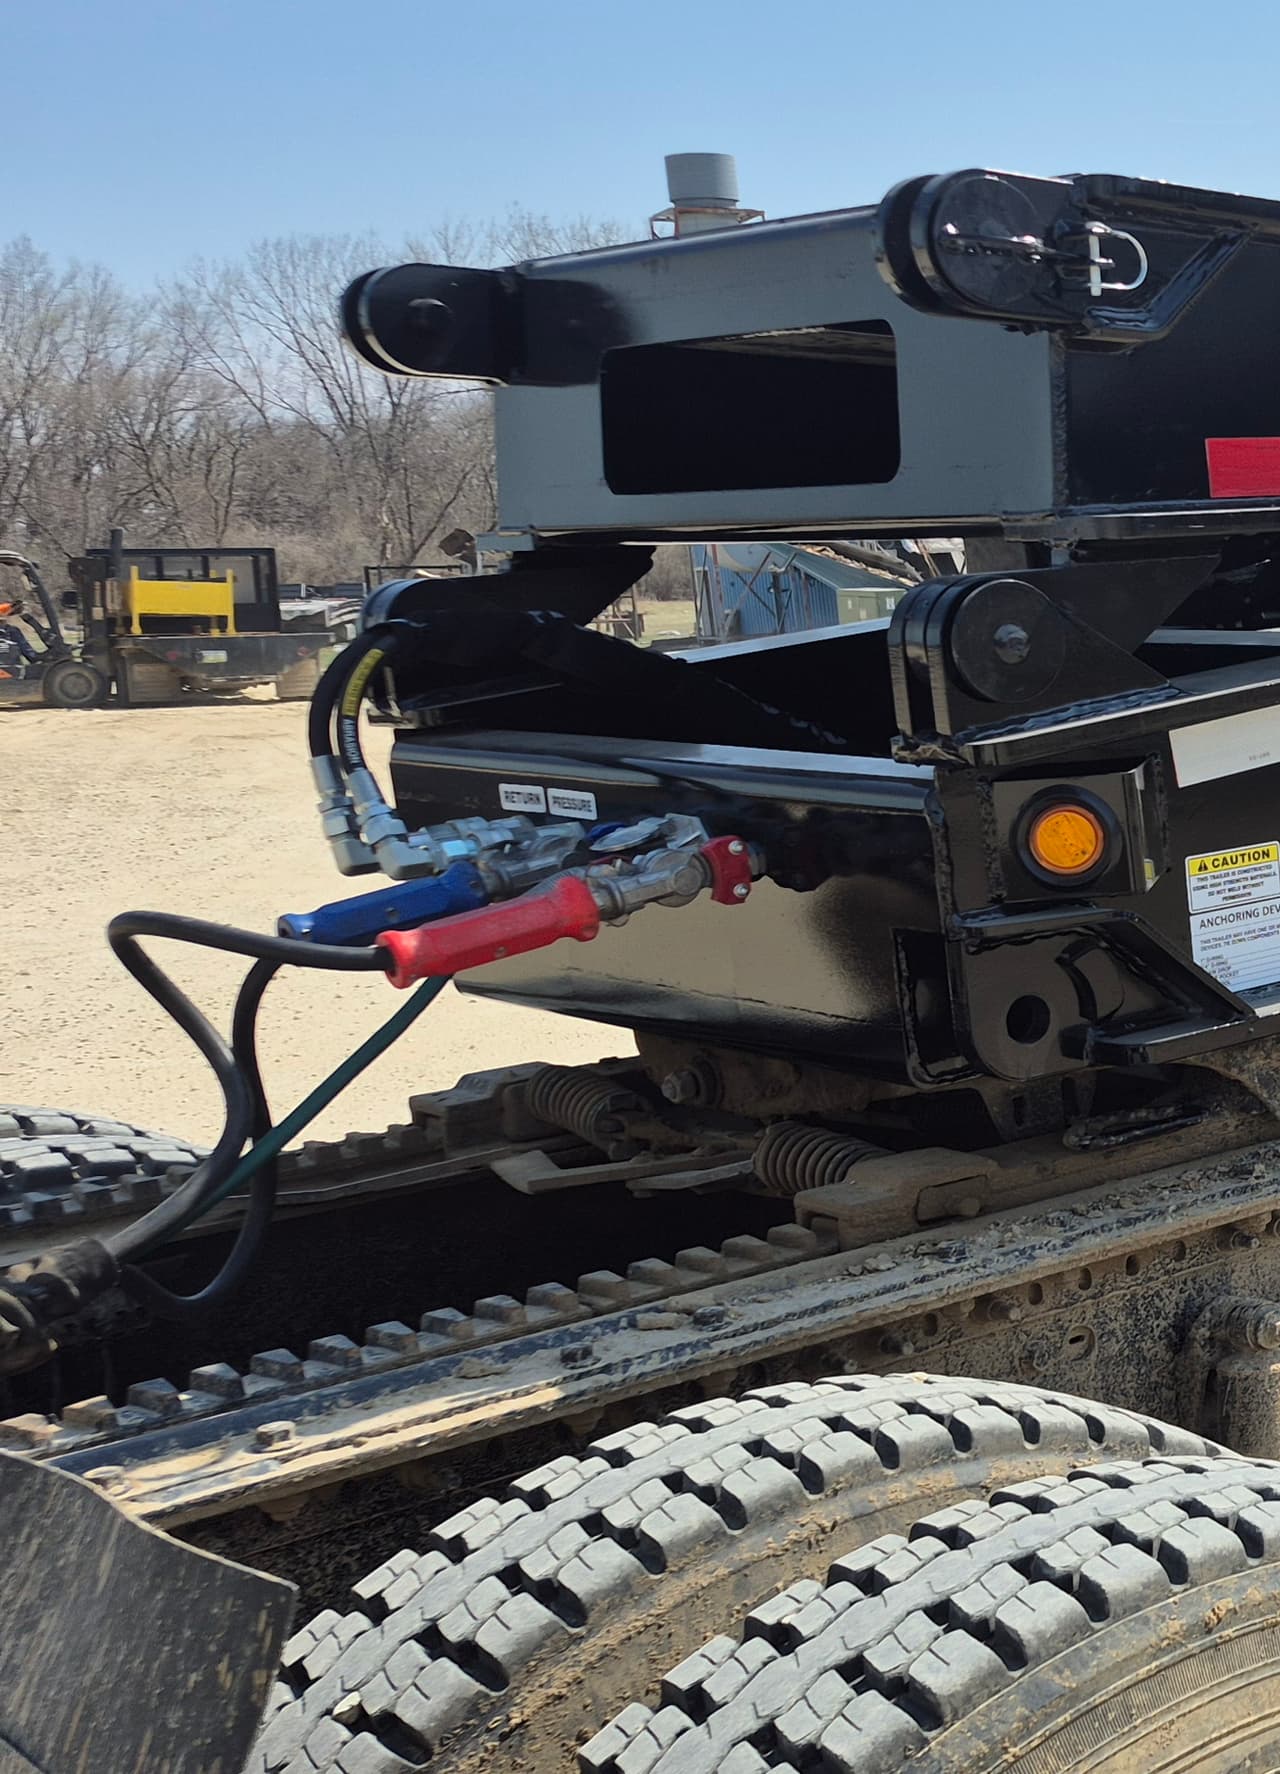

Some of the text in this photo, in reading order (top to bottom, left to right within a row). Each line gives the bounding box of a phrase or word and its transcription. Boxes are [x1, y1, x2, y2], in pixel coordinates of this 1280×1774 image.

[504, 791, 540, 805] RETURN
[551, 795, 593, 813] PRESSURE
[1212, 849, 1270, 868] CAUTION
[1200, 908, 1259, 929] ANCHORING
